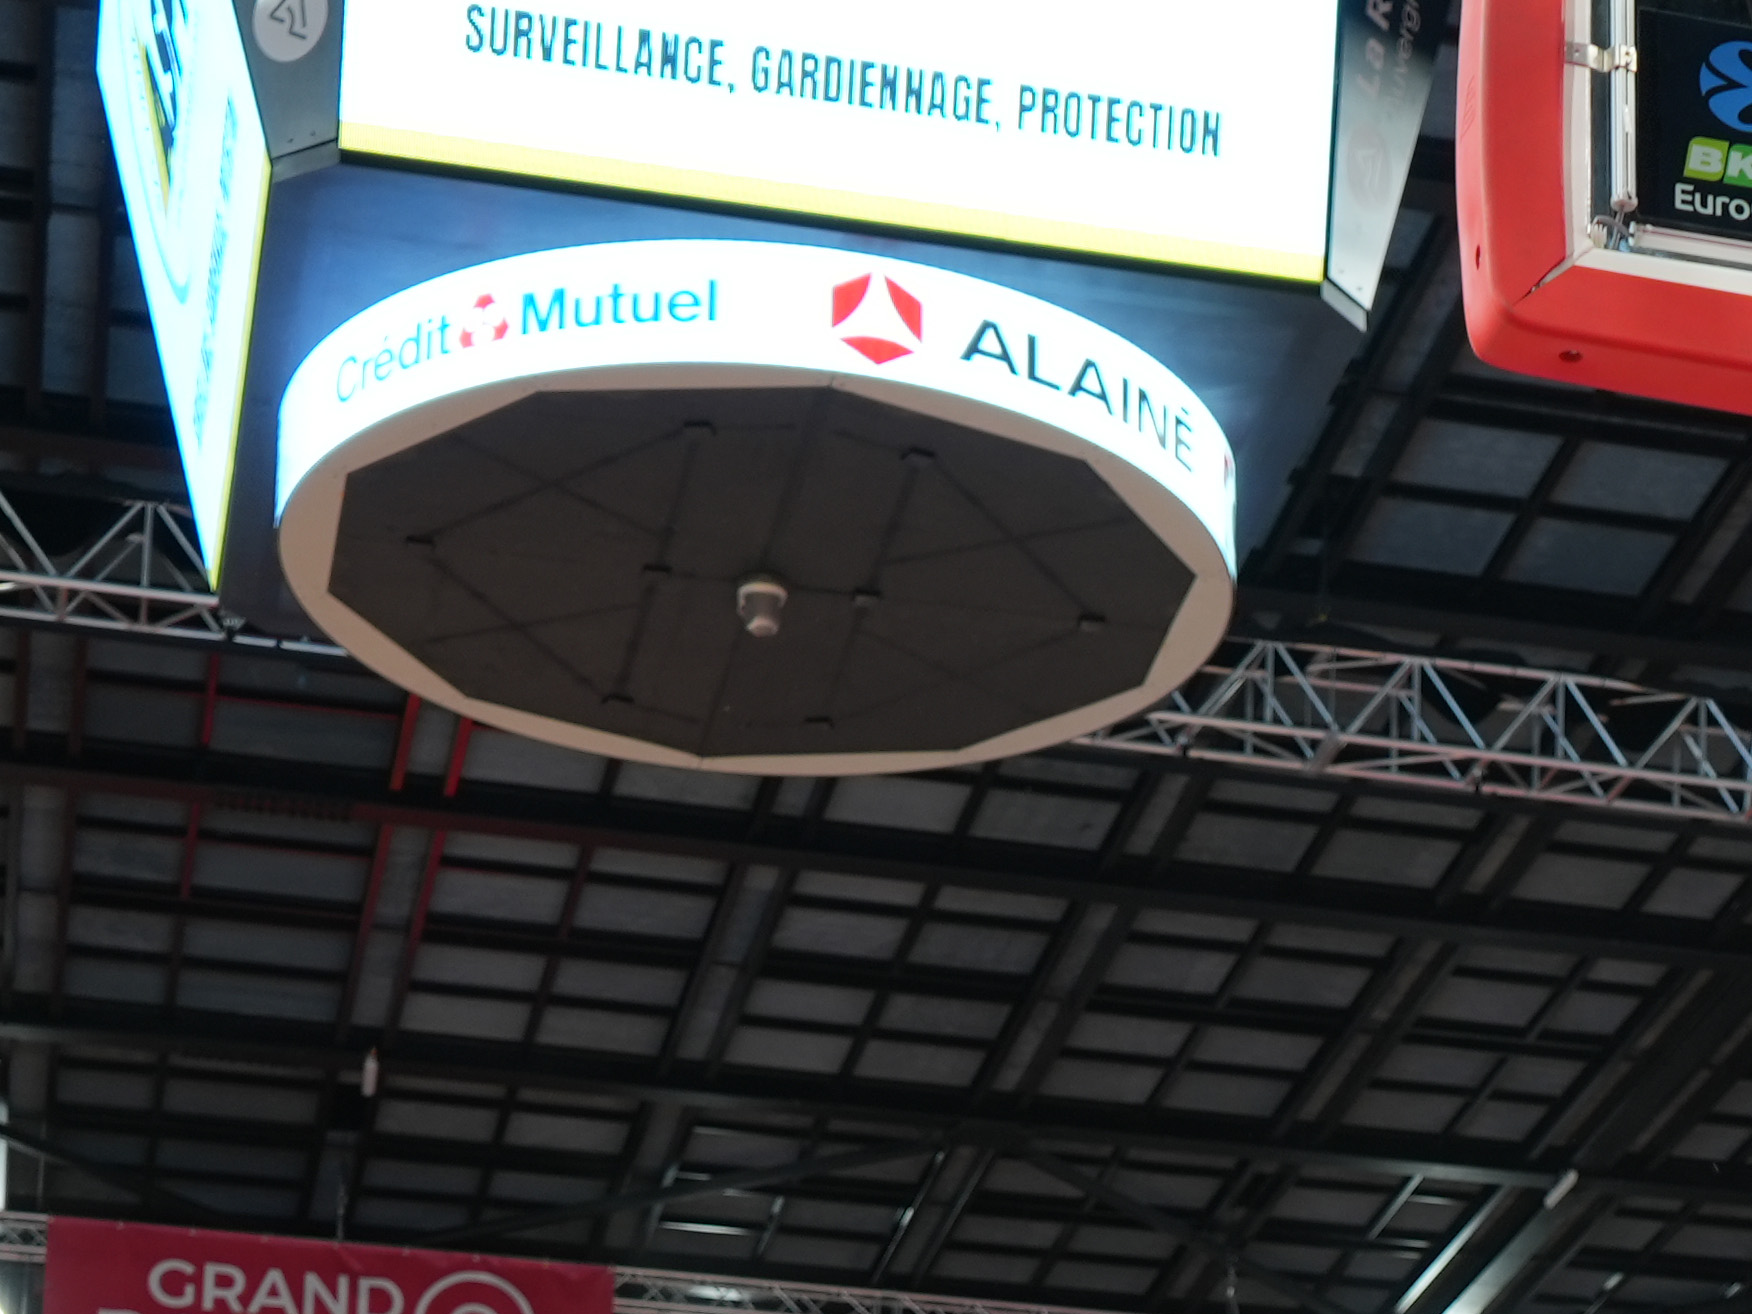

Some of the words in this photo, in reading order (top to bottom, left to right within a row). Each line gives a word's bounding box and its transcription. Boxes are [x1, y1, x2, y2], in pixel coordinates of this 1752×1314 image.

[465, 4, 735, 93] SURVEILLANCE,
[751, 47, 1000, 132] GARDIENNAGE,
[1018, 84, 1222, 157] PROTECTION
[335, 316, 452, 403] Crédit
[520, 279, 719, 336] Mutuel
